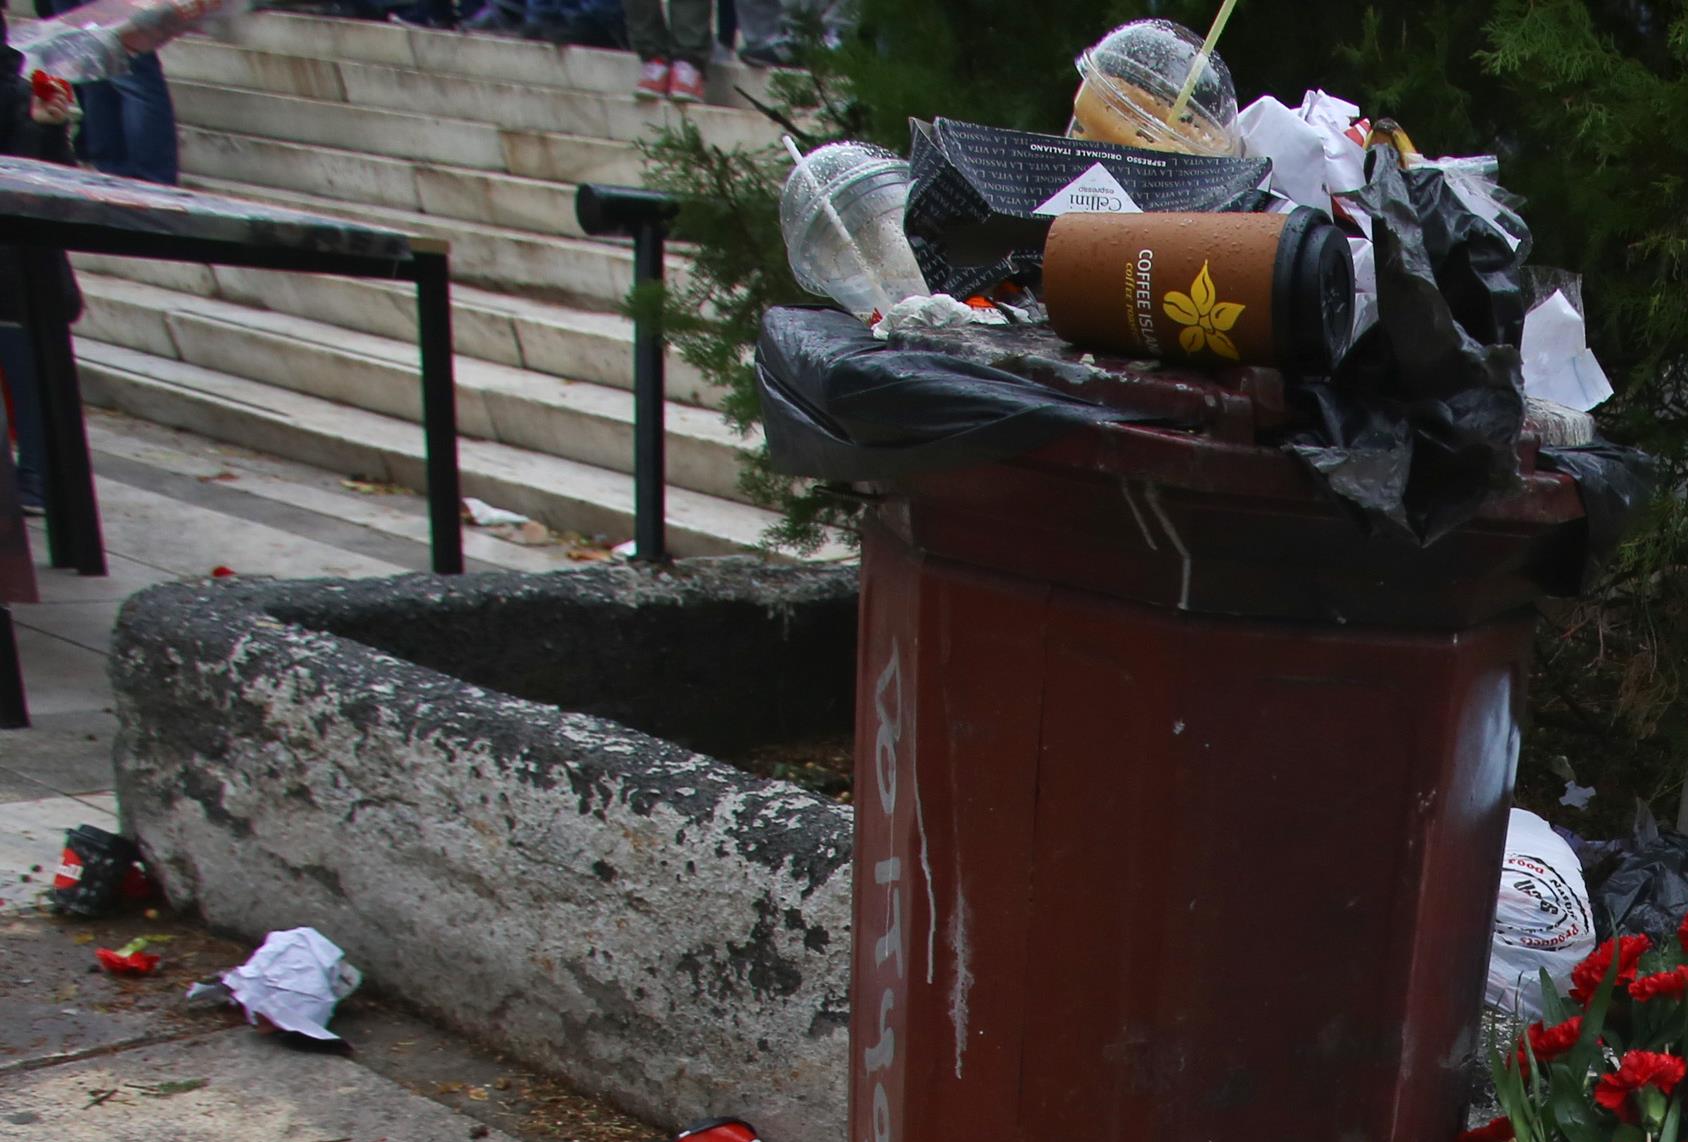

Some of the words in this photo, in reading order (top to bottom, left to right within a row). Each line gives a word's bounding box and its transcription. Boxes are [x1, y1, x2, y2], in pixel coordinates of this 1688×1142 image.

[1030, 143, 1071, 155] ITALIANO
[1076, 149, 1122, 161] ORIGINALE
[1127, 155, 1166, 167] ESPRESSO
[1078, 187, 1115, 195] espresso
[1069, 194, 1122, 212] Cellini
[1136, 249, 1153, 309] COFFEE
[1138, 313, 1160, 355] ISLAN
